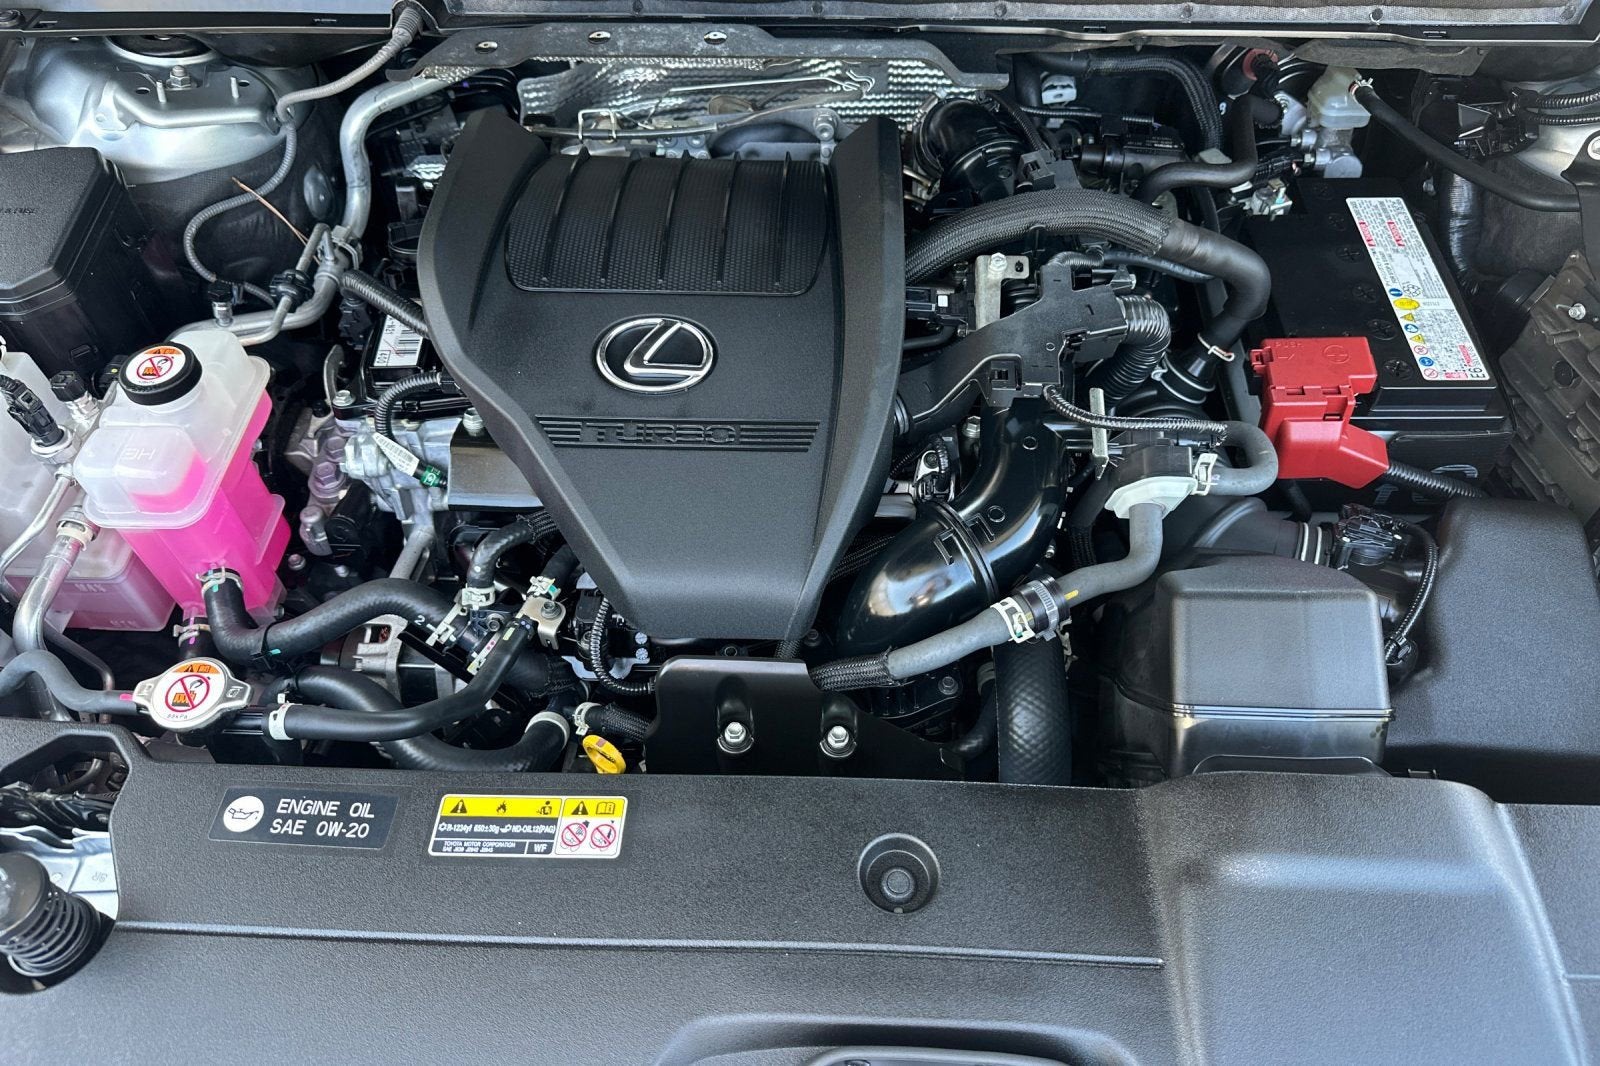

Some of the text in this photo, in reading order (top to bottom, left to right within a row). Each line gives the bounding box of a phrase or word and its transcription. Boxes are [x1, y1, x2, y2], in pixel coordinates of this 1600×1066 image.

[585, 421, 737, 444] TURBO
[276, 798, 375, 818] ENGINE OIL
[270, 819, 370, 839] SAE 0W-20
[483, 841, 516, 849] CORPORATION
[534, 843, 548, 853] WF
